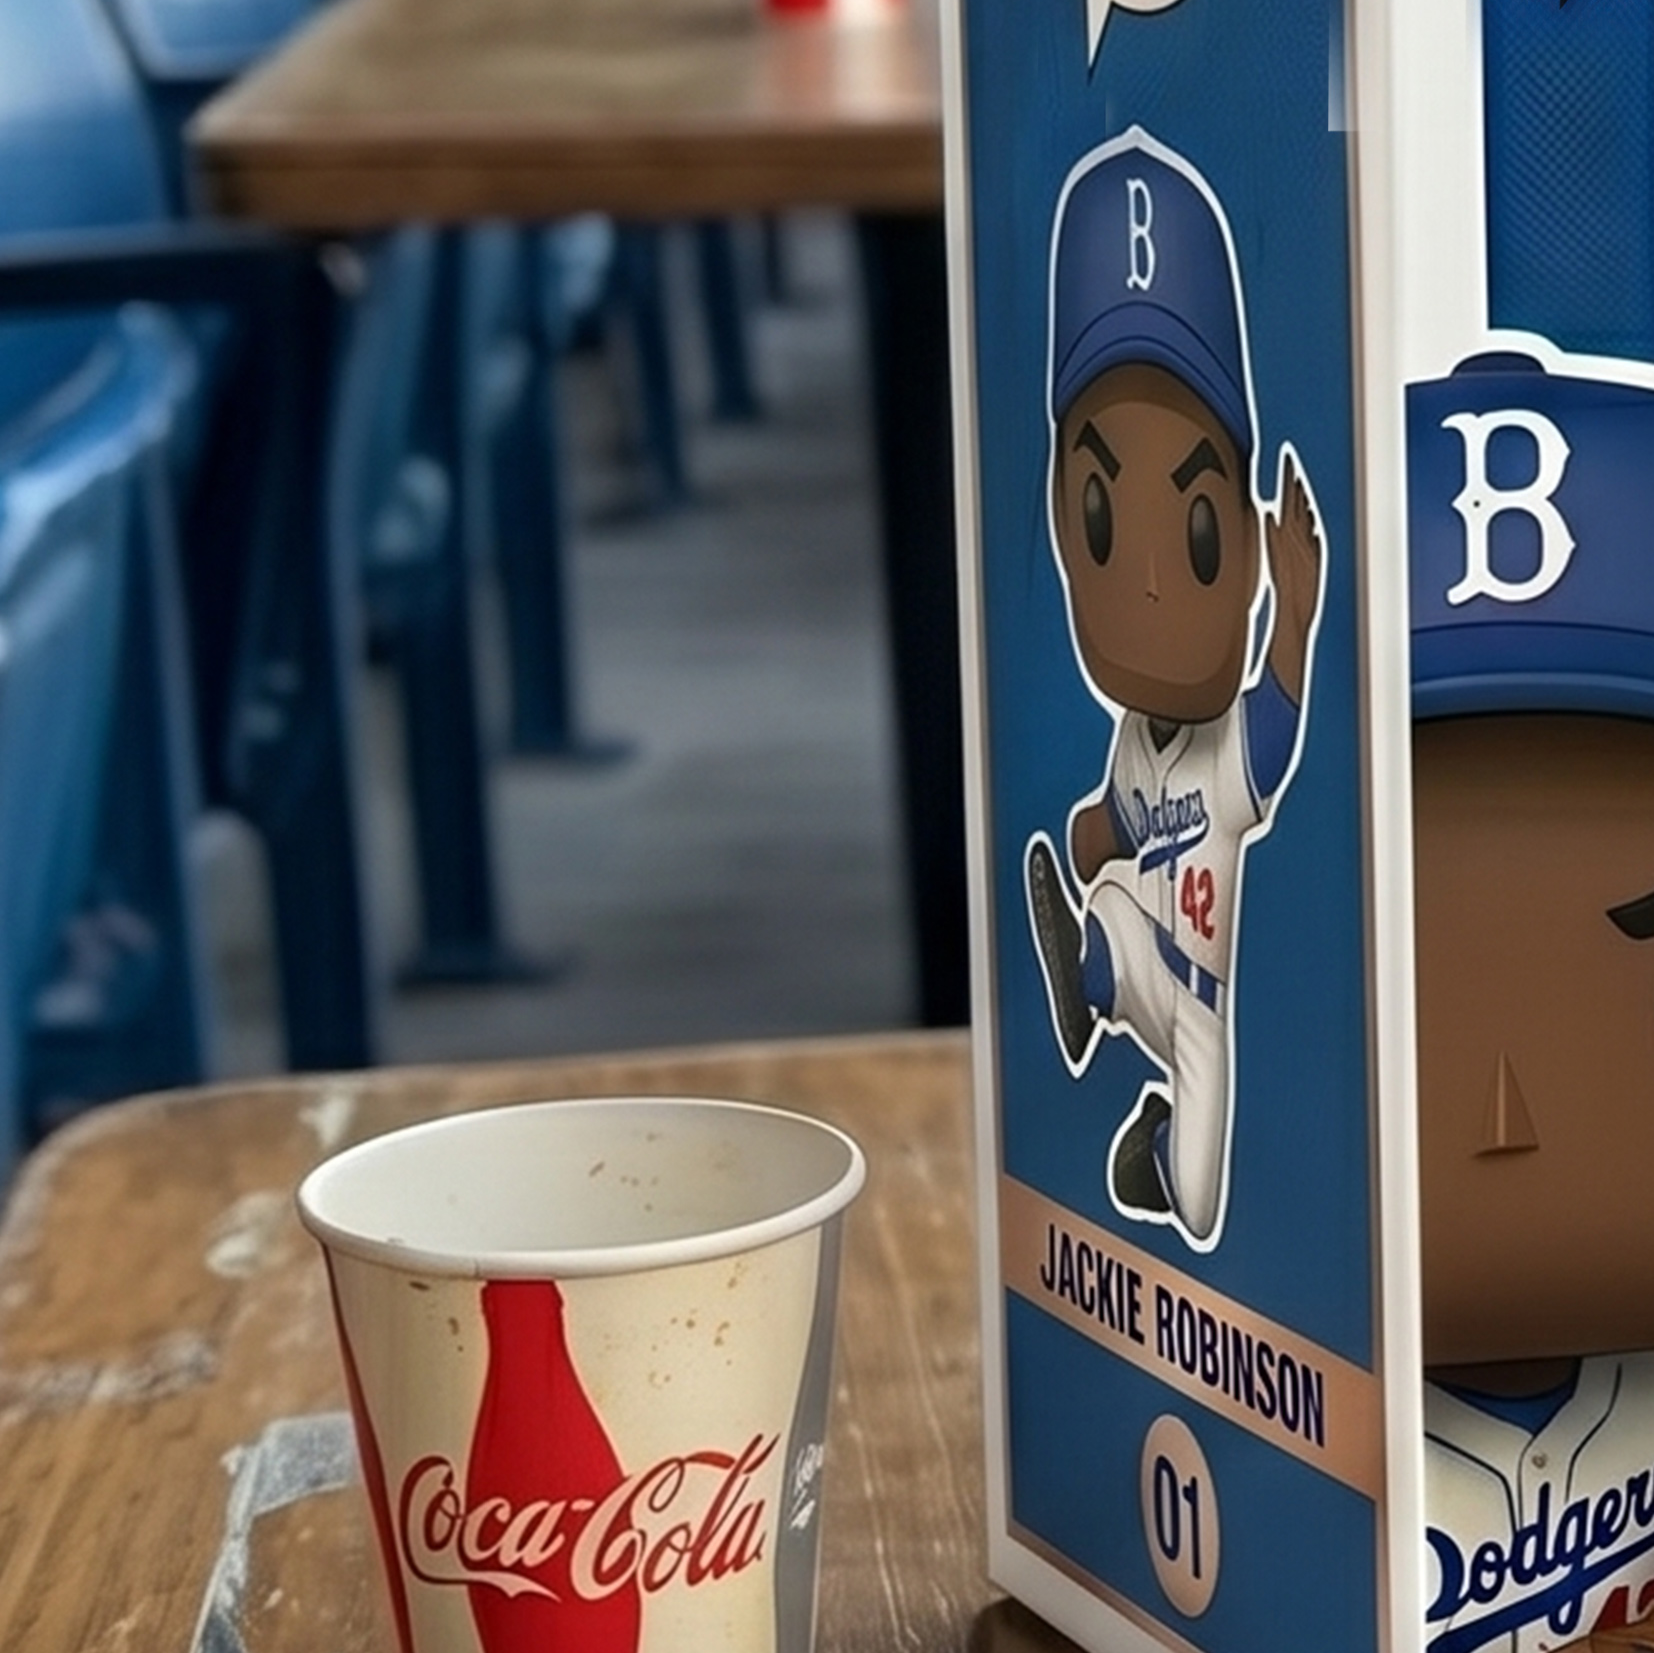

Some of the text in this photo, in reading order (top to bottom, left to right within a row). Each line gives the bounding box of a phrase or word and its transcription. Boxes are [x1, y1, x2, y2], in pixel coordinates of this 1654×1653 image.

[1127, 179, 1156, 289] B
[1440, 408, 1577, 606] B
[1179, 865, 1217, 942] 42
[1039, 1223, 1326, 1449] JACKIE ROBINSON
[400, 1433, 782, 1603] Coca-Cola
[1153, 1453, 1202, 1580] 01
